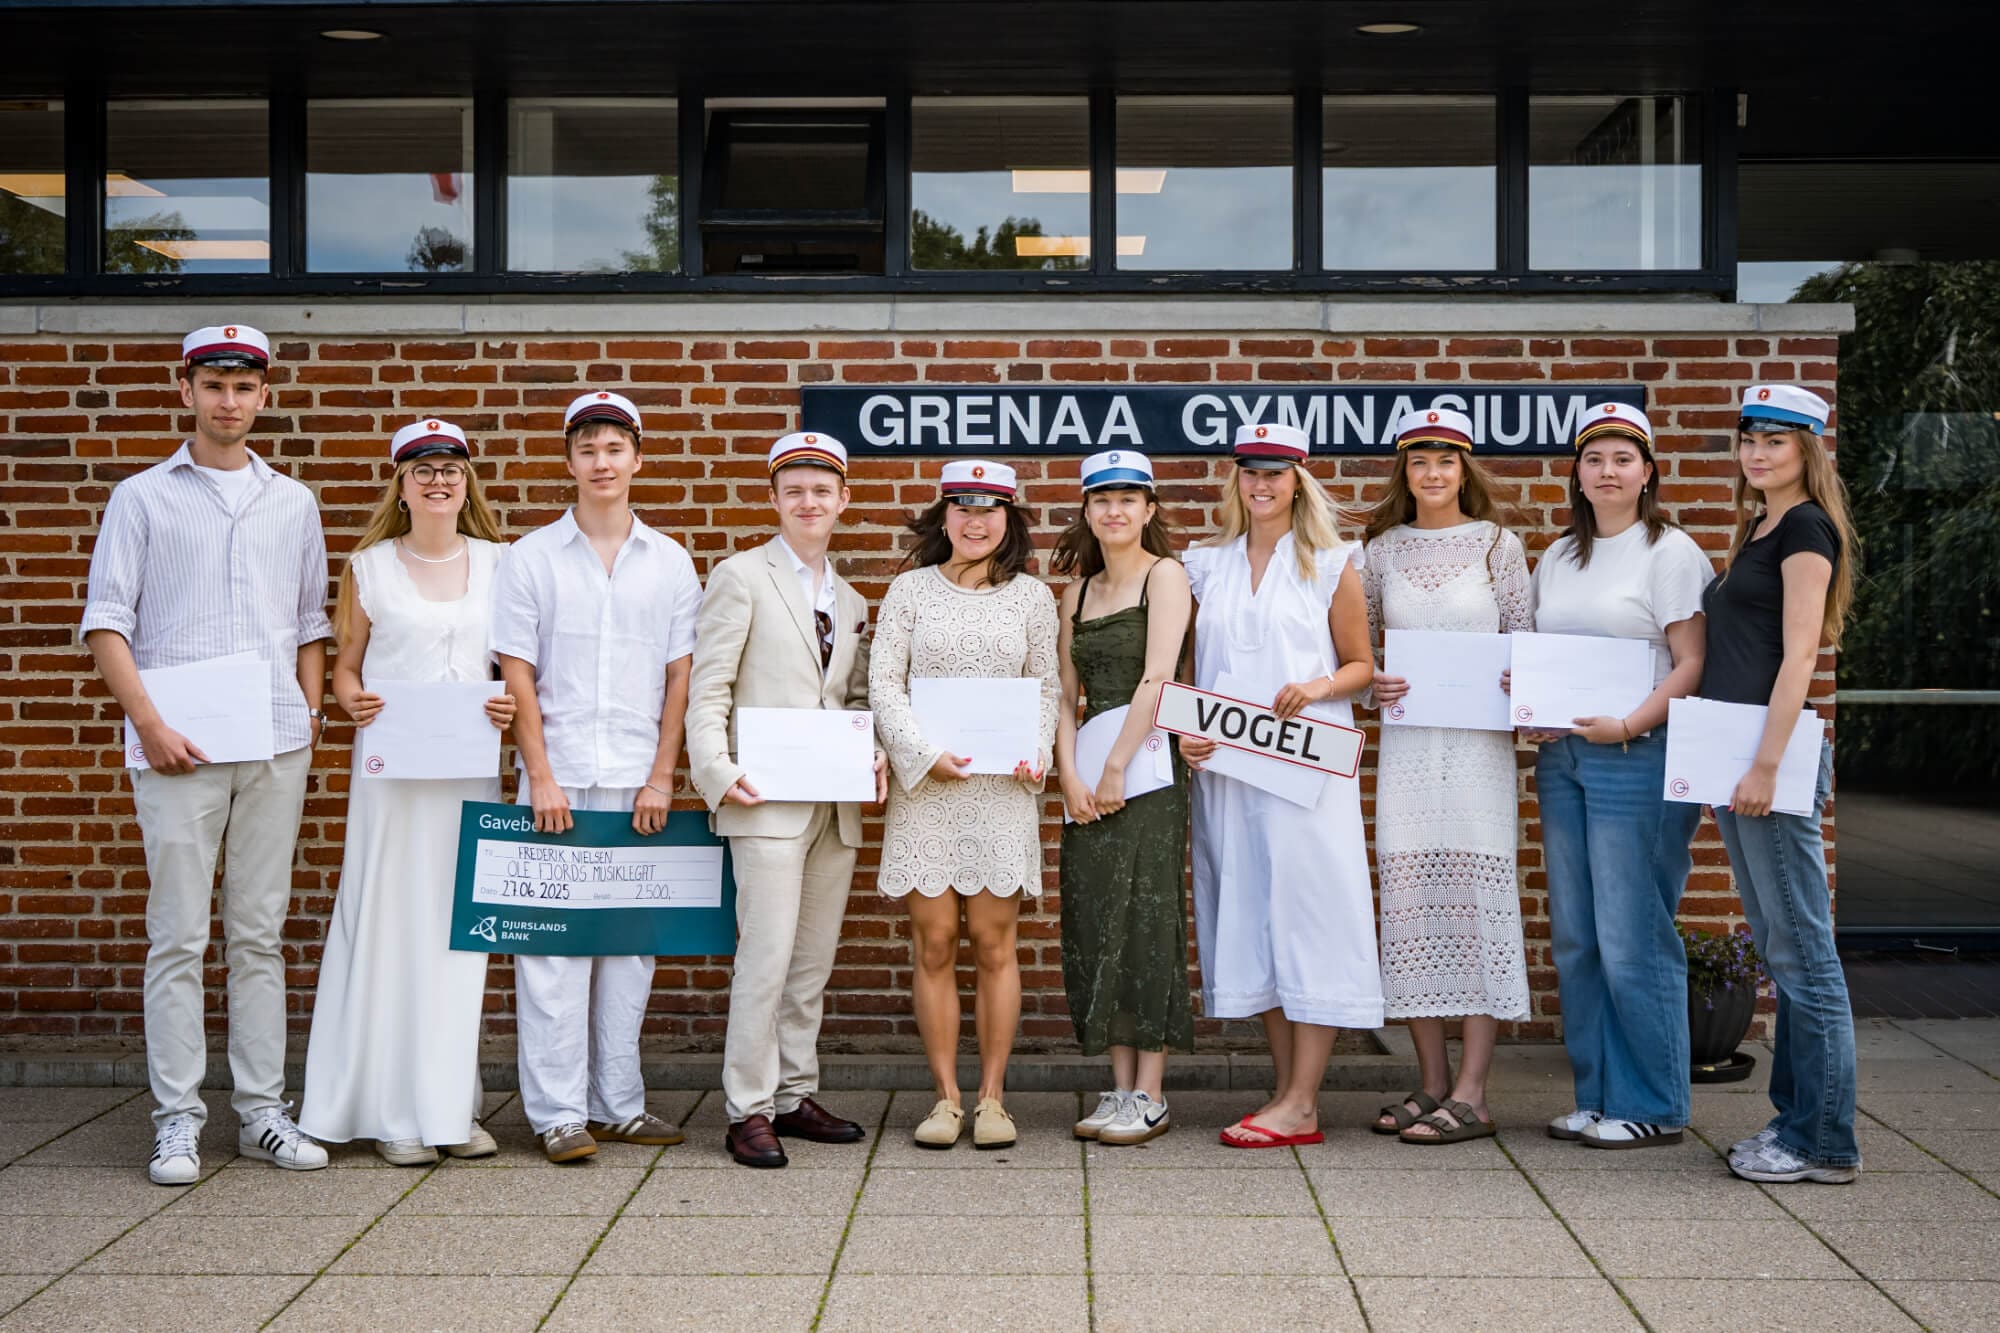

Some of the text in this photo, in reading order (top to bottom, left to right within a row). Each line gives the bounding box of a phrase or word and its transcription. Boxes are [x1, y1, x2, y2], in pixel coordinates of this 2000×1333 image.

[858, 394, 1144, 446] GRENAA
[1196, 697, 1321, 762] VOGEL
[518, 846, 566, 863] FREDERIK
[571, 850, 613, 864] NIELSEN
[508, 860, 657, 882] OLE FJORDS MUSIKLEGAT
[501, 931, 530, 941] BANK
[502, 920, 567, 932] DJURSLANDS
